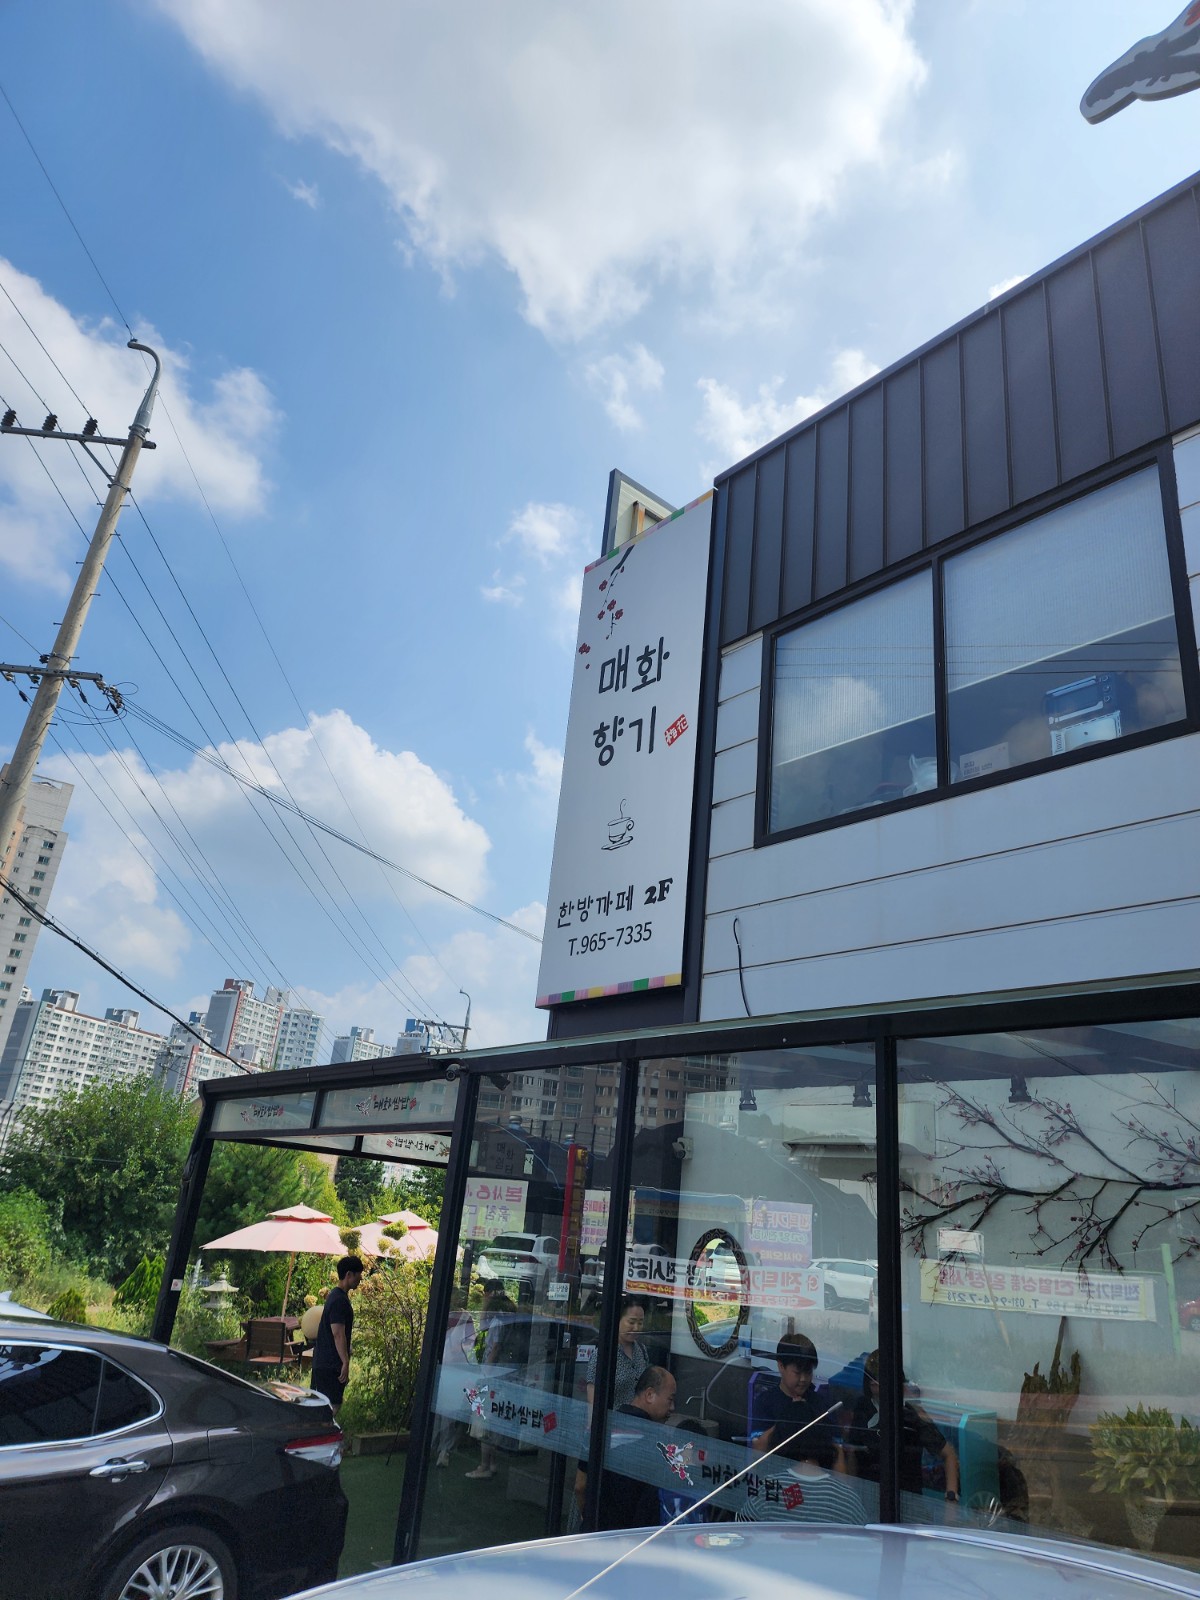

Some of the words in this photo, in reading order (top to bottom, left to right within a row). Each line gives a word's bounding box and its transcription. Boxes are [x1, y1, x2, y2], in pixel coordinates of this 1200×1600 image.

[598, 636, 671, 694] 매화
[592, 705, 657, 767] 향기
[557, 884, 634, 928] 한방까페
[644, 877, 674, 906] 2F
[568, 921, 653, 957] T.965-7335
[374, 1096, 410, 1111] 매화쌈밥
[491, 1401, 544, 1429] 매화쌈밥
